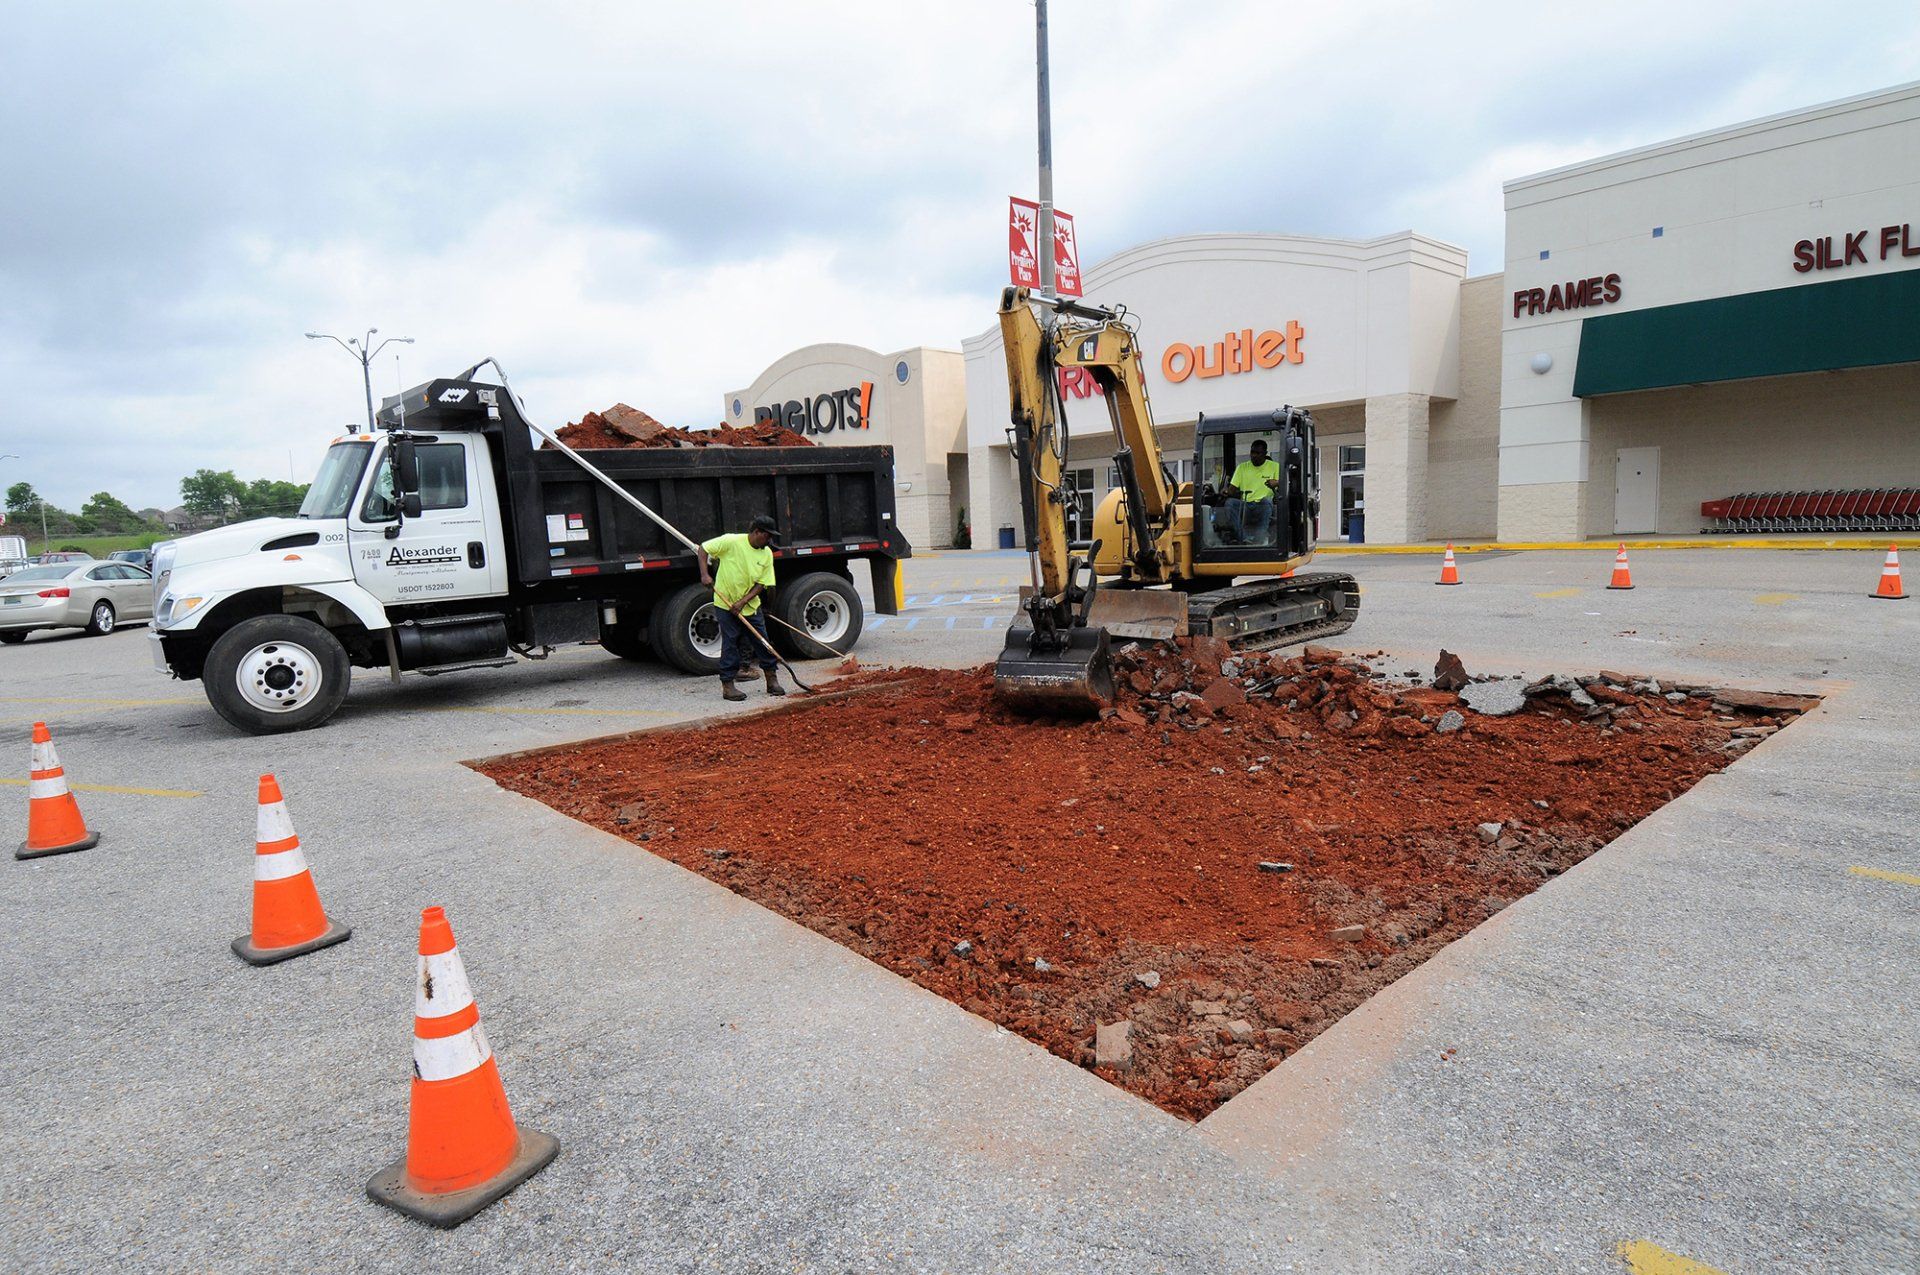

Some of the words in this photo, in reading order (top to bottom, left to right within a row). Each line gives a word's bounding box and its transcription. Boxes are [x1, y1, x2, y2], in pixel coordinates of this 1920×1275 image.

[1793, 230, 1868, 273] SILK
[1880, 223, 1920, 260] FL
[1513, 273, 1622, 318] FRAMES
[325, 533, 345, 542] 002
[389, 546, 458, 562] Alexander
[398, 585, 423, 594] USDOT
